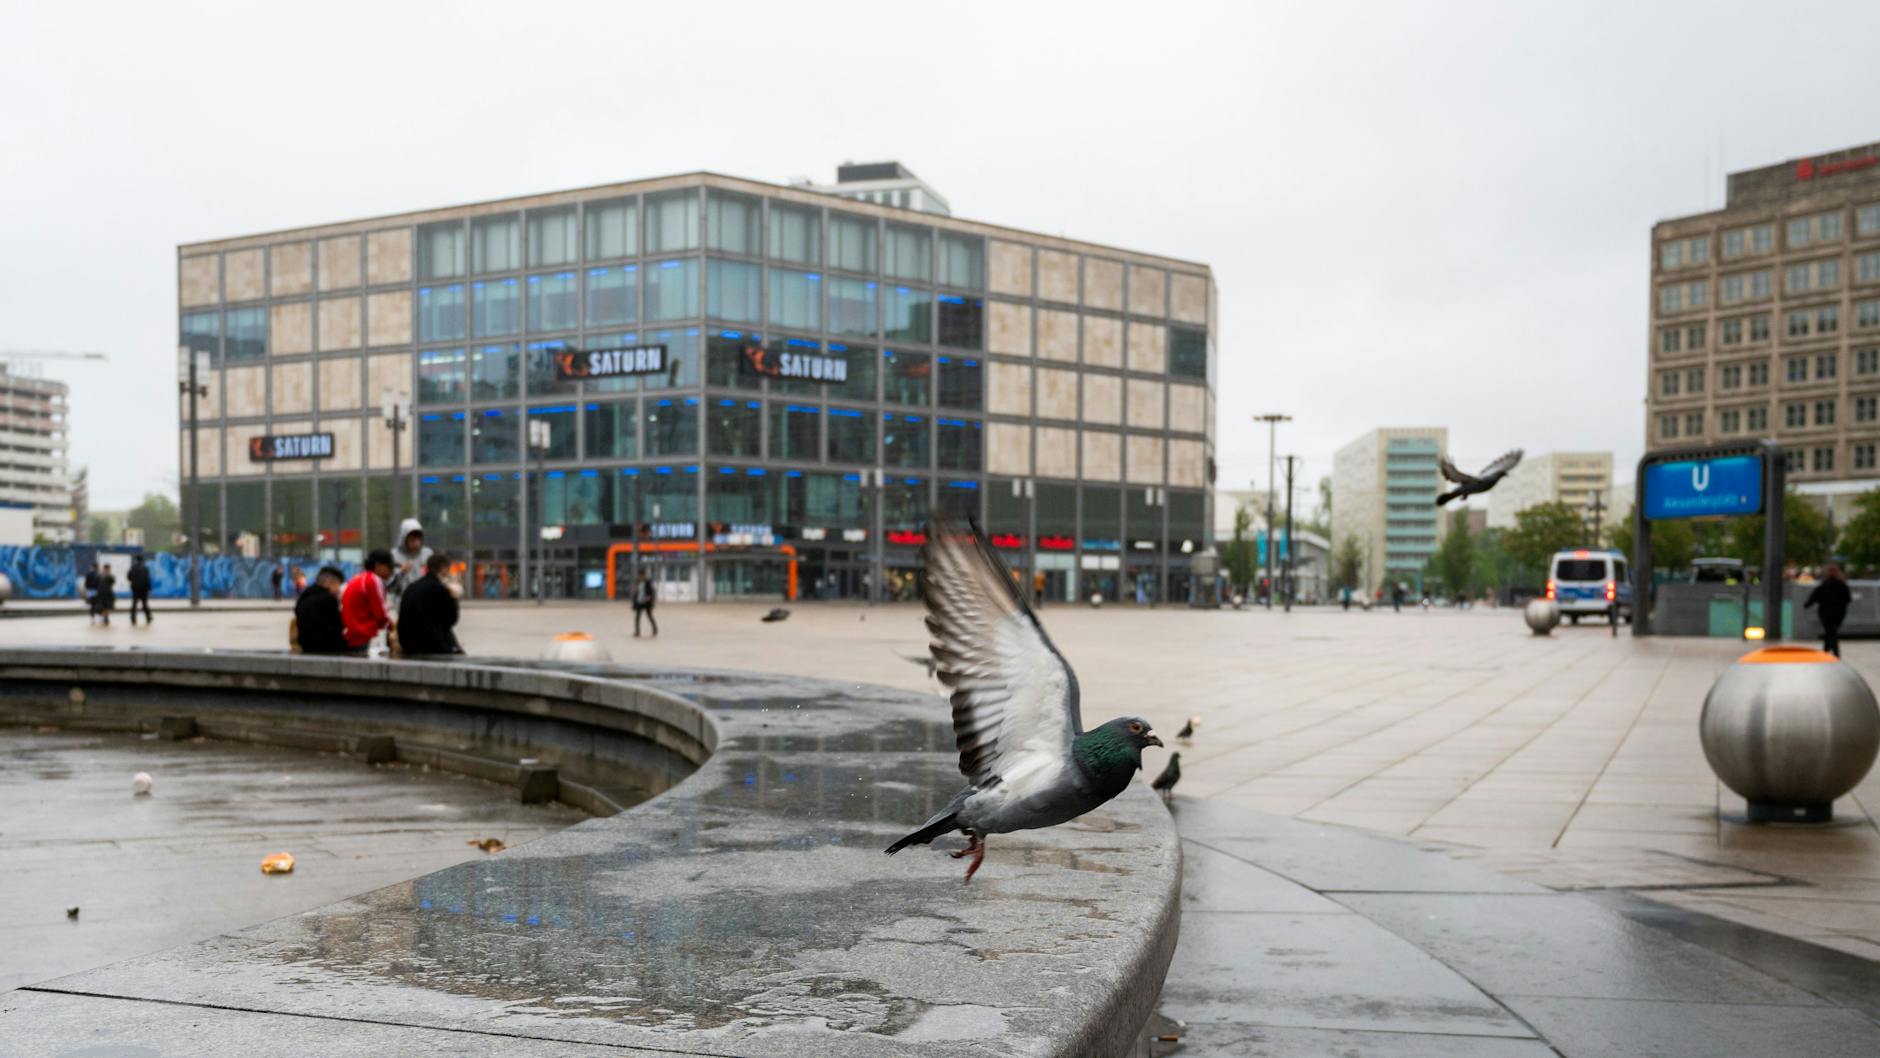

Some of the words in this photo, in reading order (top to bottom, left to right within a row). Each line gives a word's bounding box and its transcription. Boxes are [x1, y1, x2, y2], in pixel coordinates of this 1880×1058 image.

[589, 348, 661, 375] SATURN
[779, 352, 847, 381] SATURN
[274, 433, 331, 458] SATURN
[1692, 463, 1710, 491] U
